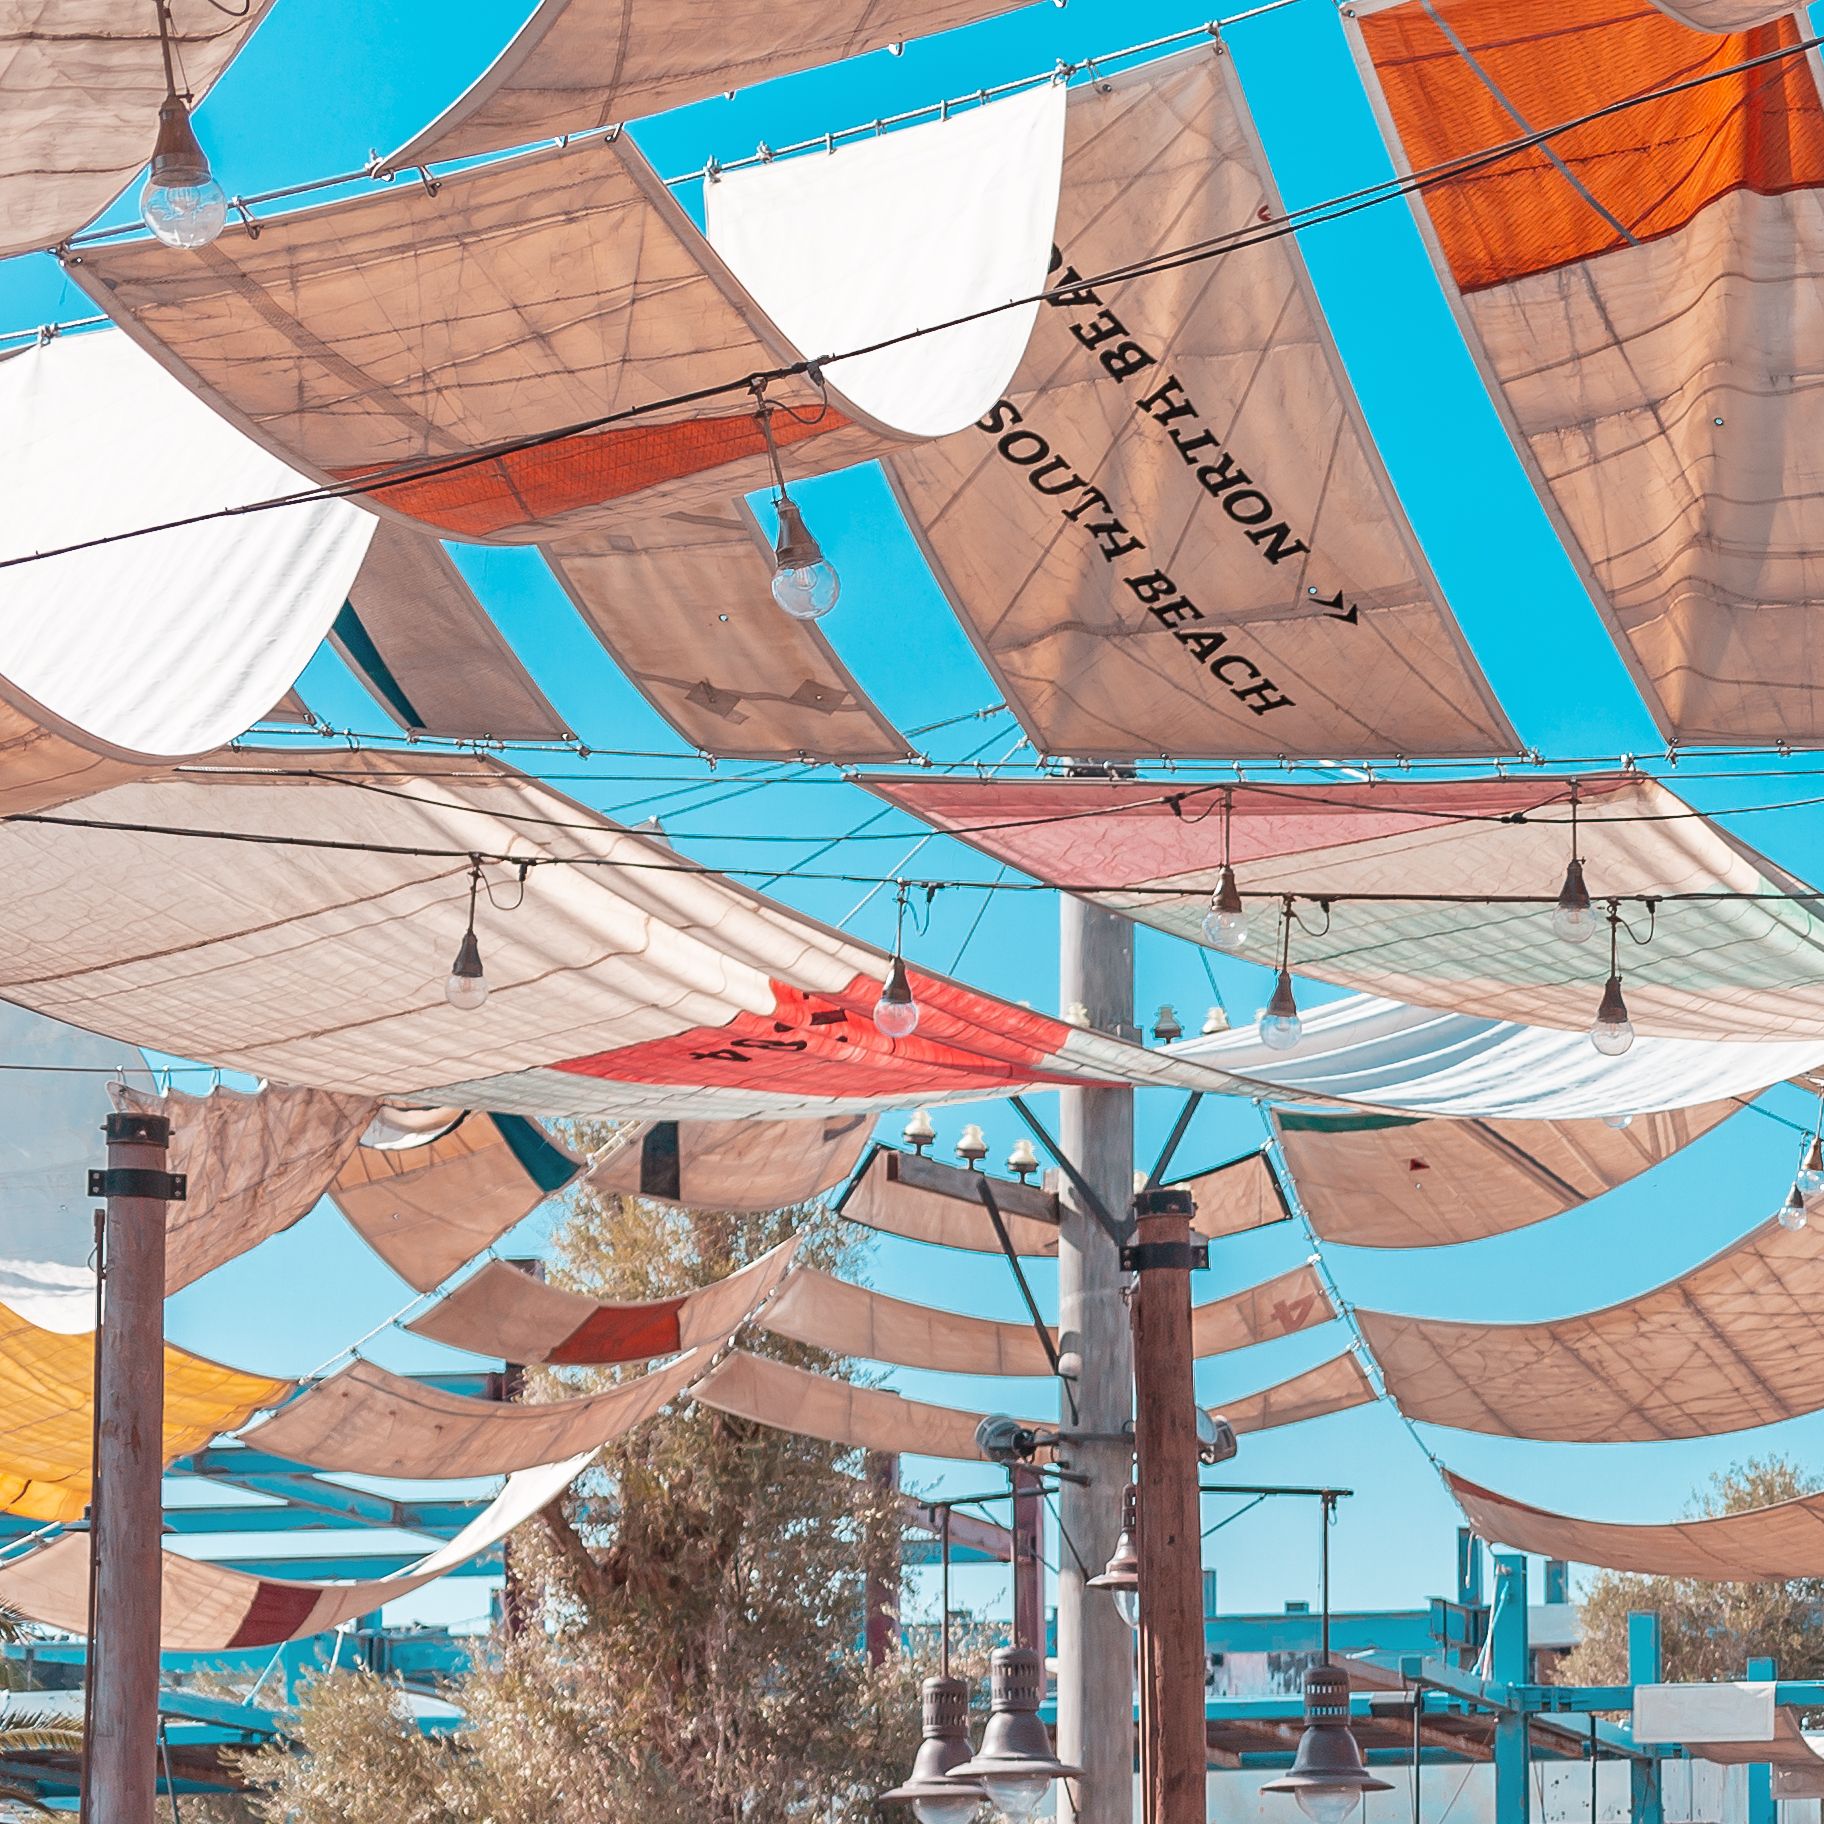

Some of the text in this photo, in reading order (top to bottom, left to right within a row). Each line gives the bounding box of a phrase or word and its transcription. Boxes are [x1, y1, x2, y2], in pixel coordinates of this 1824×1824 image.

[974, 399, 1297, 717] SOUTH BEACH
[1045, 242, 1311, 565] NORTH BEA
